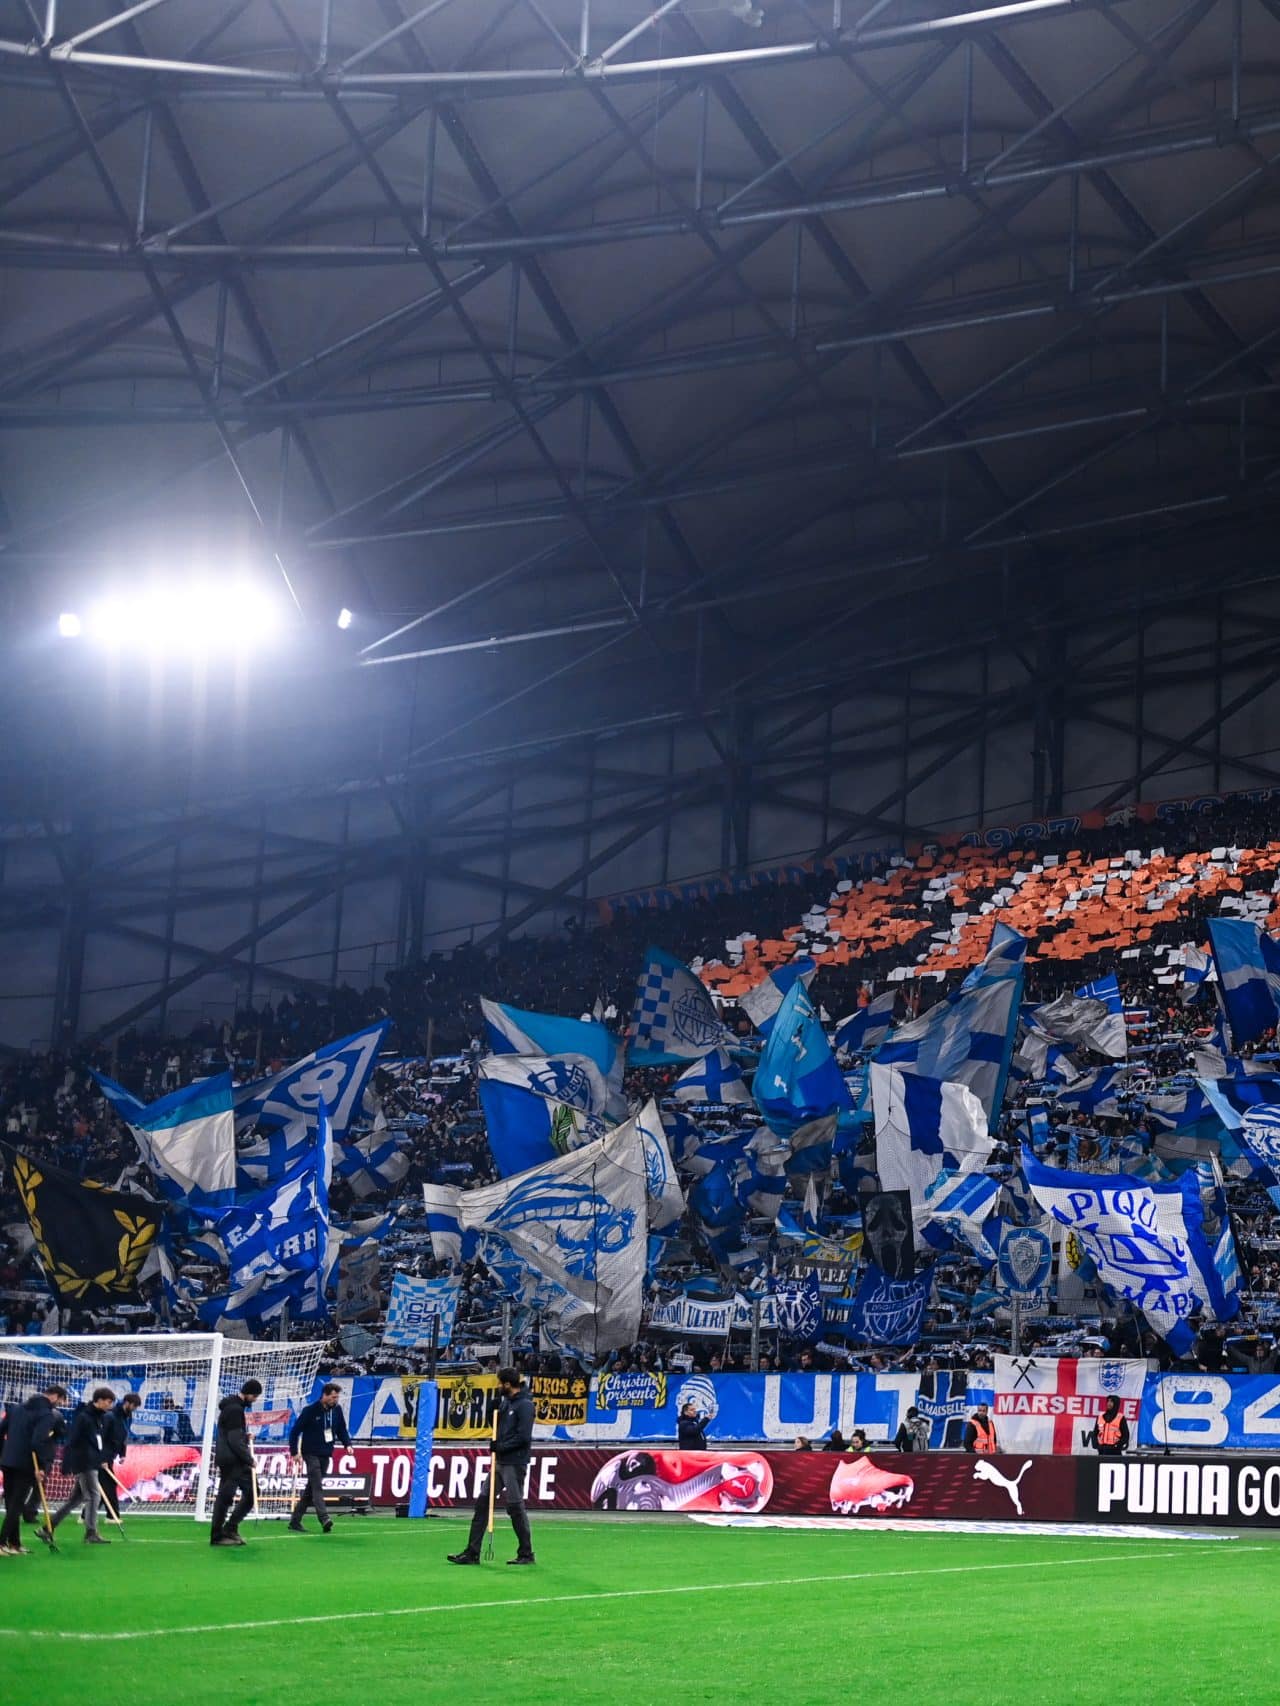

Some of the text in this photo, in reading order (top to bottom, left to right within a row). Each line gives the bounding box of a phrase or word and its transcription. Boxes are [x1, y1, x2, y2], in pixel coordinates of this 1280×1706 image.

[997, 1394, 1138, 1420] MARSEILE
[373, 1454, 406, 1499] TO
[428, 1455, 559, 1501] CRETE
[1097, 1462, 1230, 1516] PUMA
